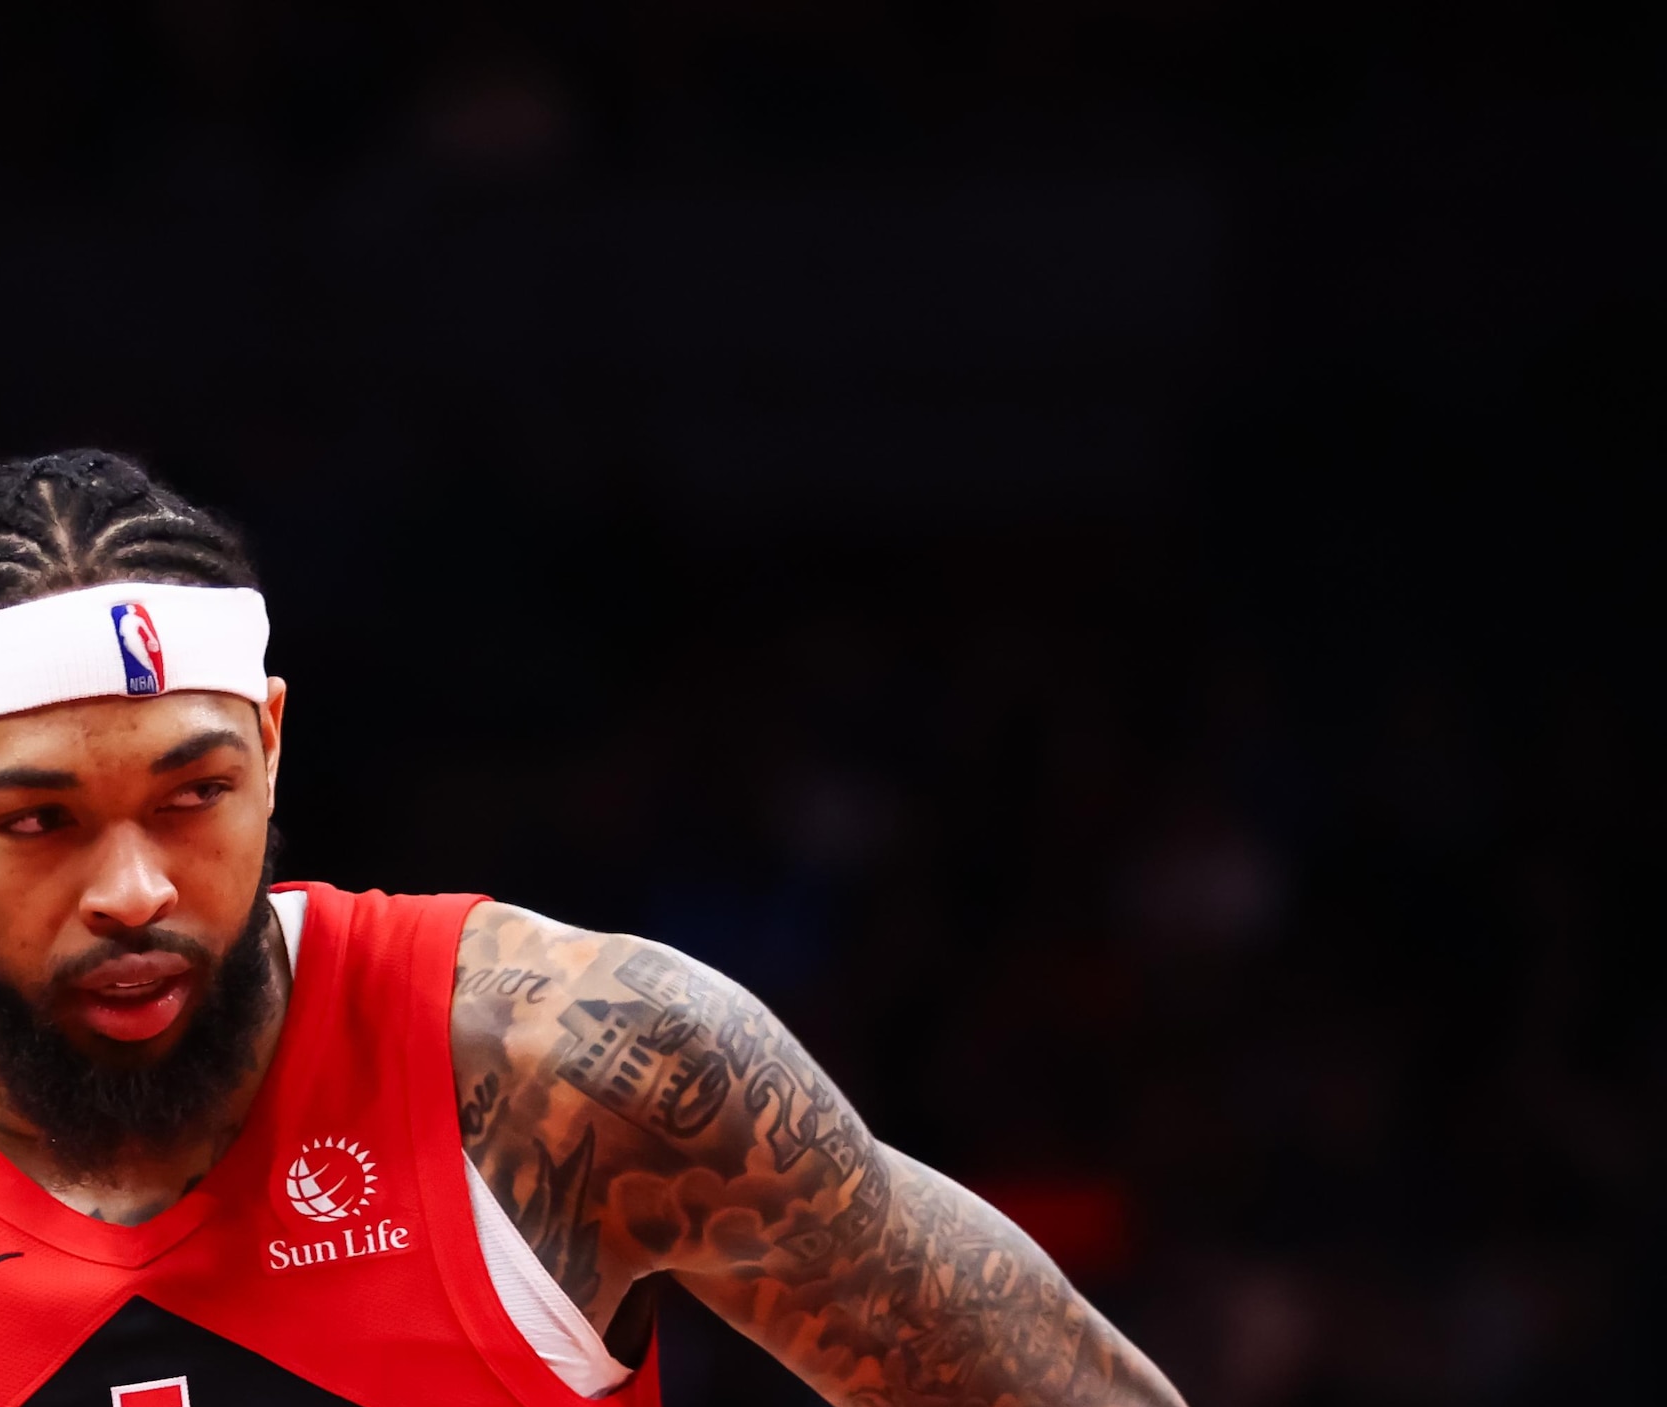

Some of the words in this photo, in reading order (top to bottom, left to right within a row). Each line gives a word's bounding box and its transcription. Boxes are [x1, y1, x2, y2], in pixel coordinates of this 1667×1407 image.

[129, 674, 156, 692] NBA
[268, 1240, 338, 1270] Sun
[341, 1218, 411, 1258] Life
